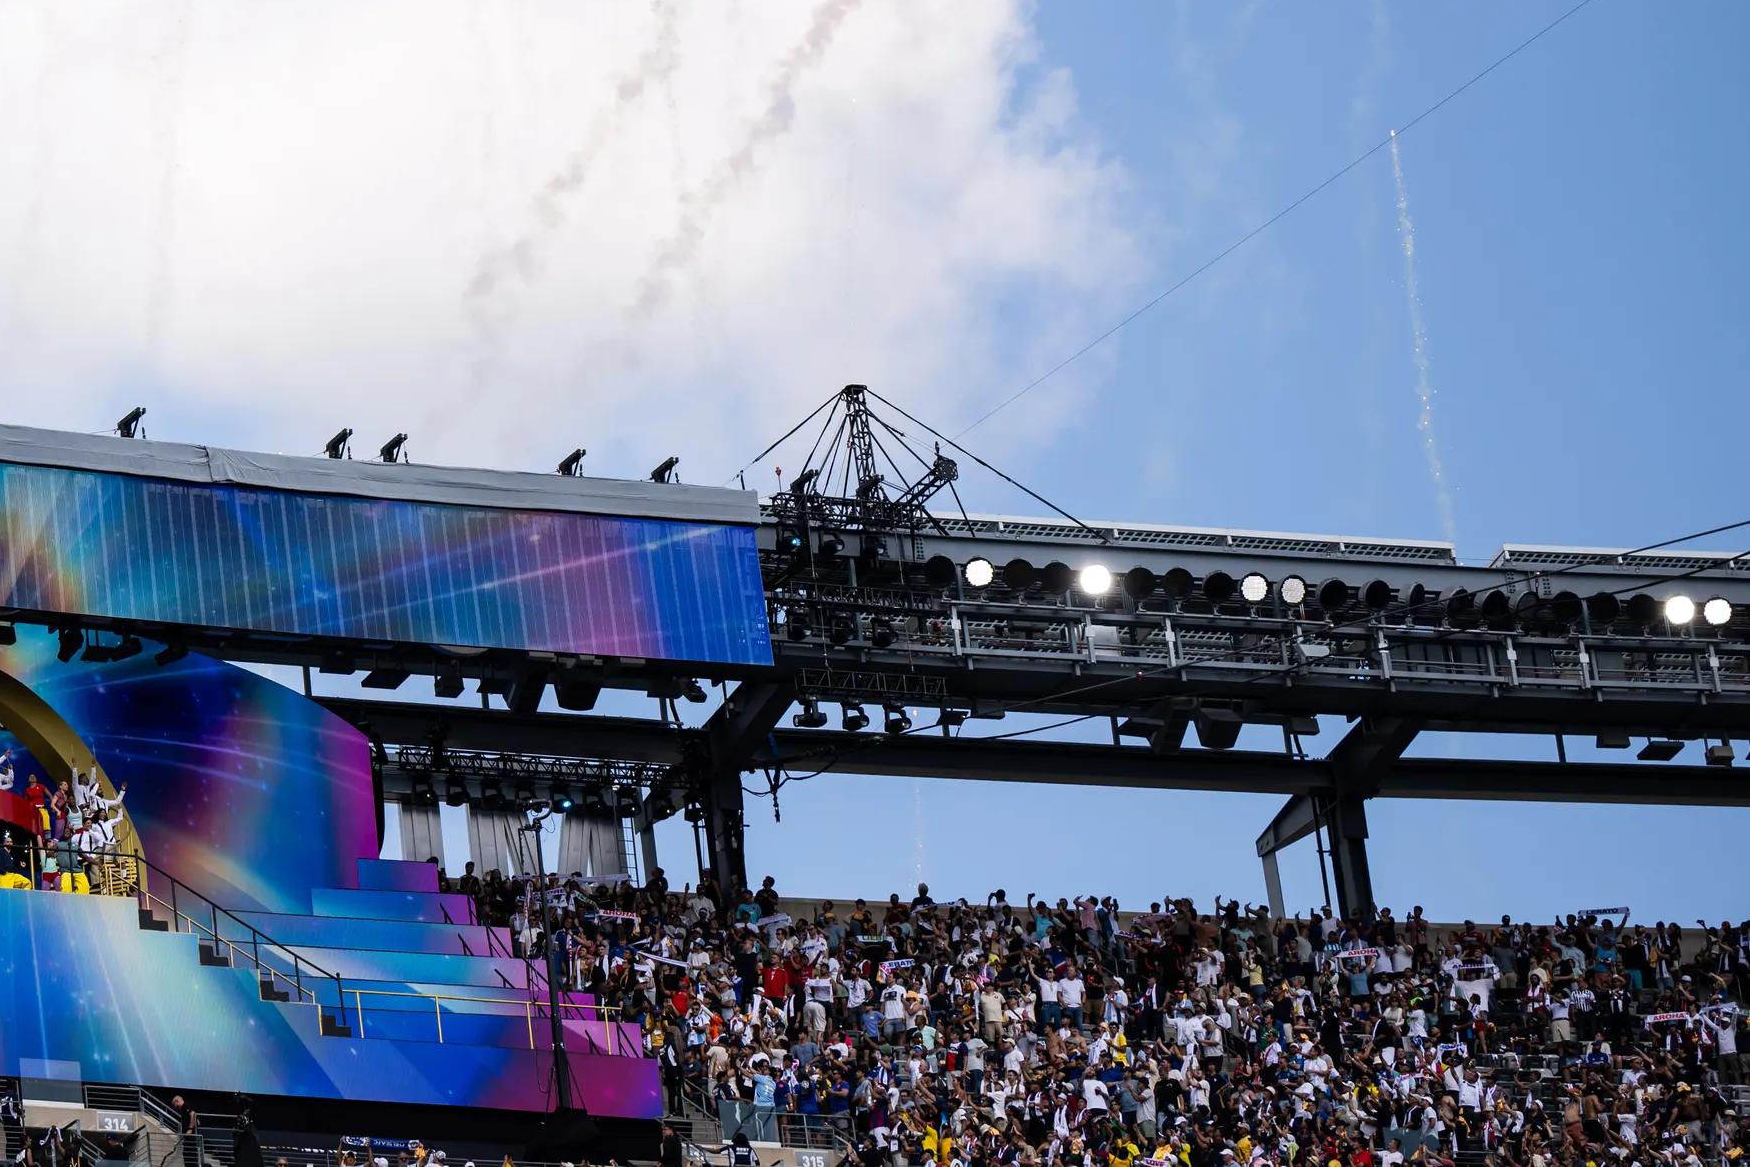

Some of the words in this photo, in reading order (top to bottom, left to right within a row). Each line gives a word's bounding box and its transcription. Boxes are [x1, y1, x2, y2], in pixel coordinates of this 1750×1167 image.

[1653, 1013, 1685, 1022] AROHA
[105, 1117, 129, 1131] 314
[802, 1155, 824, 1167] 315
